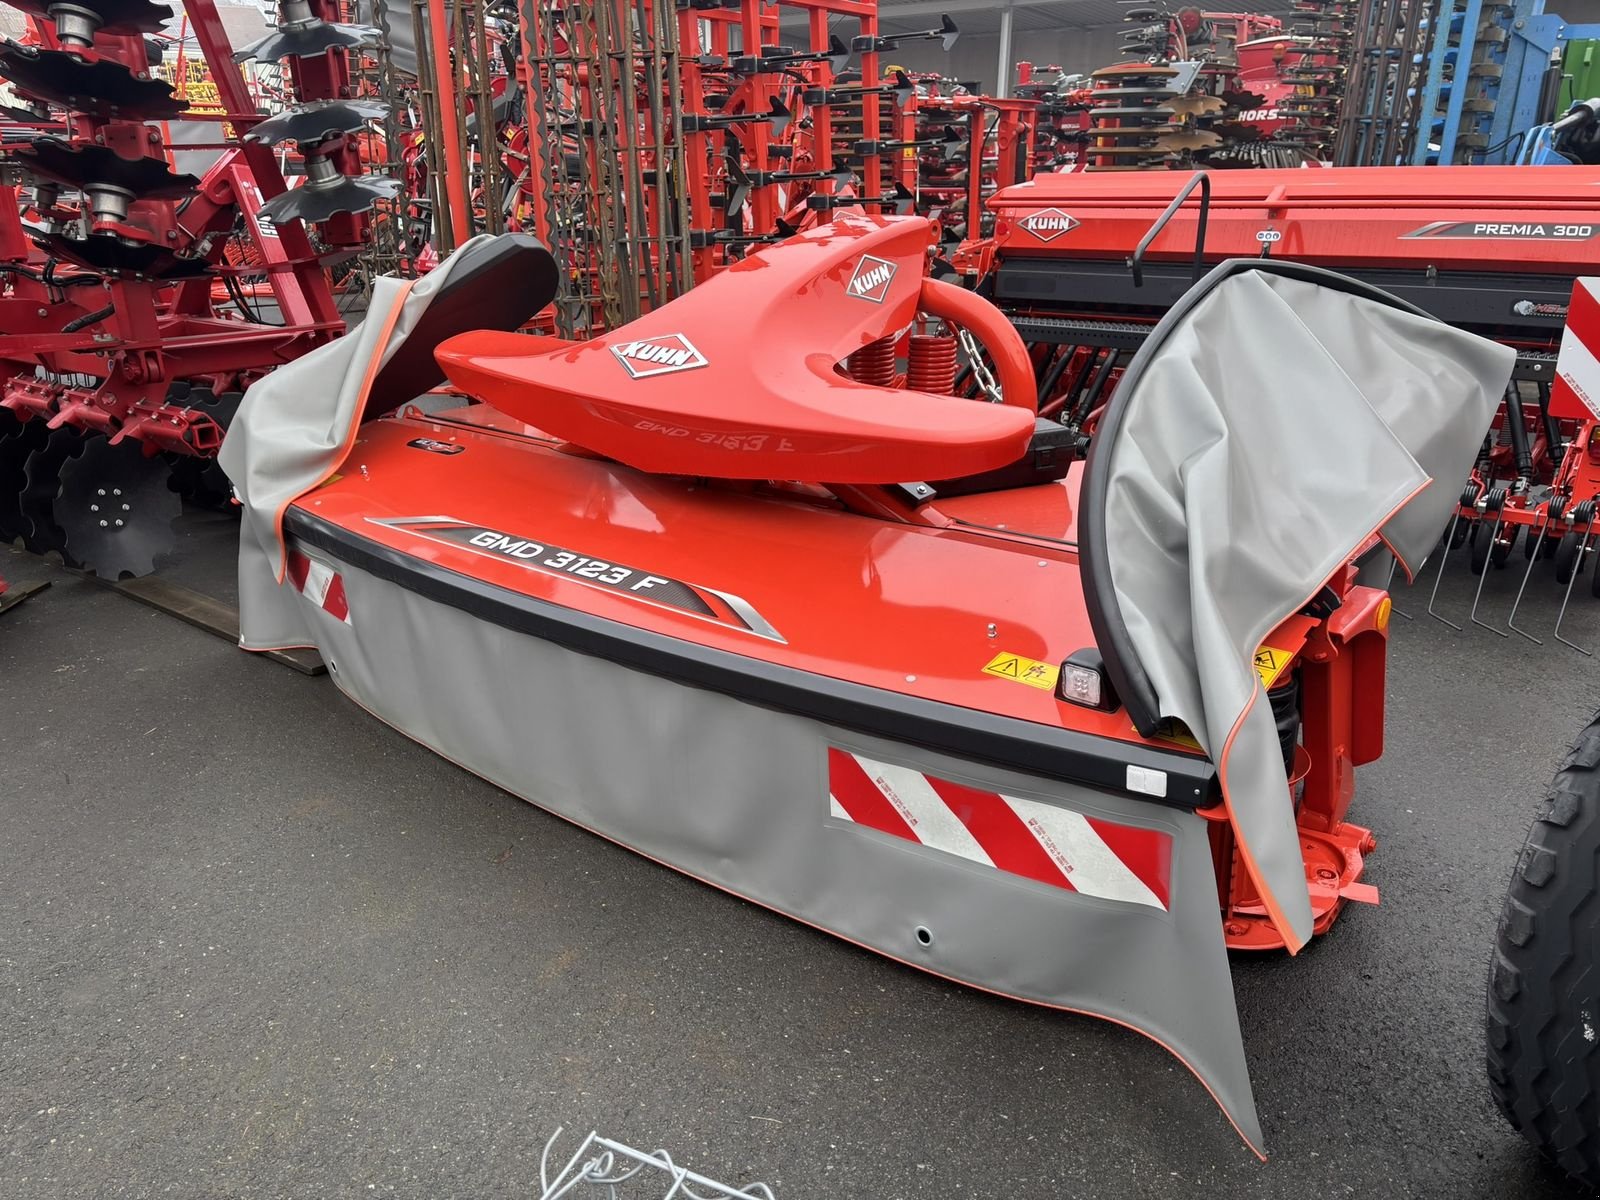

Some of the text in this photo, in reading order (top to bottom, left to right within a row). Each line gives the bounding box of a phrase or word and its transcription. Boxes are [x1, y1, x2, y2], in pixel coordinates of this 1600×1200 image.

[1238, 108, 1289, 121] HORS
[1027, 217, 1070, 230] KUHN
[1473, 223, 1592, 237] PREMIA 300
[853, 263, 891, 295] KUHN
[620, 341, 694, 367] KUHN
[469, 531, 669, 591] GMD 3123 F
